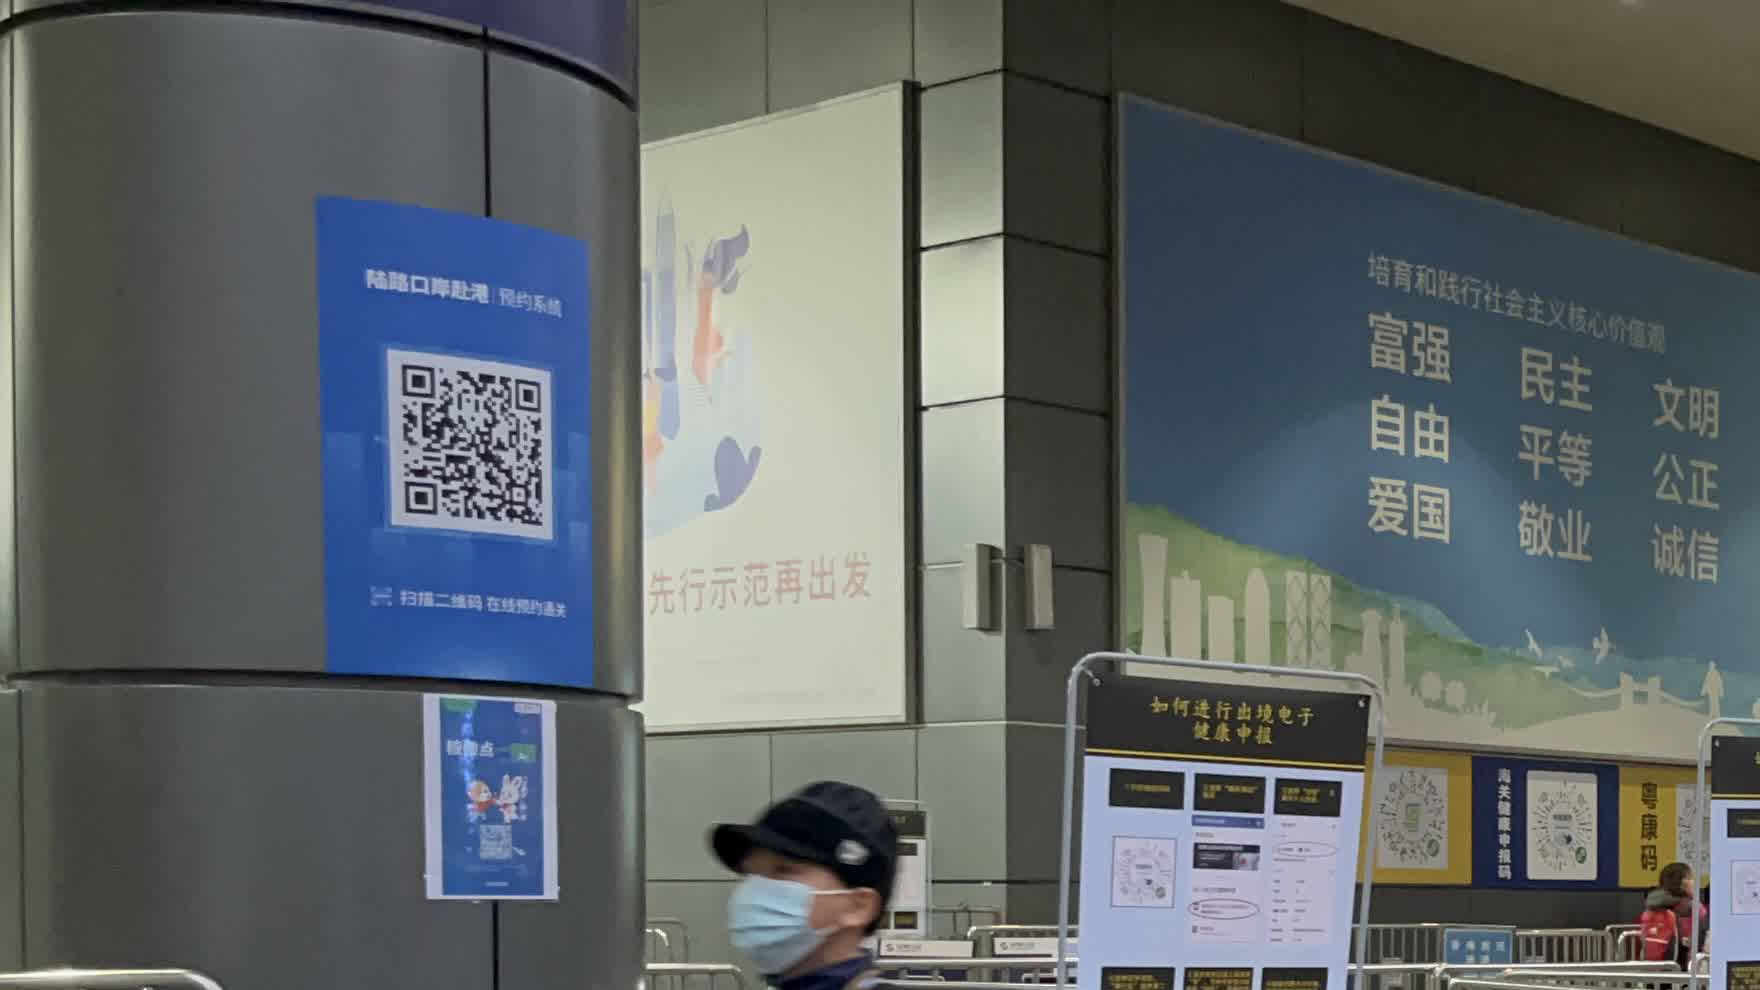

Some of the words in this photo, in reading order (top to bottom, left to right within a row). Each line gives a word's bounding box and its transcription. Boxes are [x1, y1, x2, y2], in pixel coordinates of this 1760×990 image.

[1367, 252, 1666, 354] 培育和践行社会主义核心价值观
[1367, 312, 1453, 385] 富强
[1519, 347, 1593, 413] 民主
[1652, 378, 1720, 440] 文明
[1368, 394, 1451, 463] 自由
[1518, 424, 1593, 488] 平等
[1652, 451, 1720, 511] 公正
[1367, 476, 1451, 544] 爱国
[1518, 500, 1593, 562] 敬业
[1652, 523, 1719, 584] 诚信
[400, 588, 482, 612] 扫描二维码
[649, 551, 872, 616] 先行示范再出发
[1149, 695, 1315, 727] 如何进行出境电子
[1193, 720, 1273, 745] 健康申报
[1640, 781, 1658, 872] 粤康码
